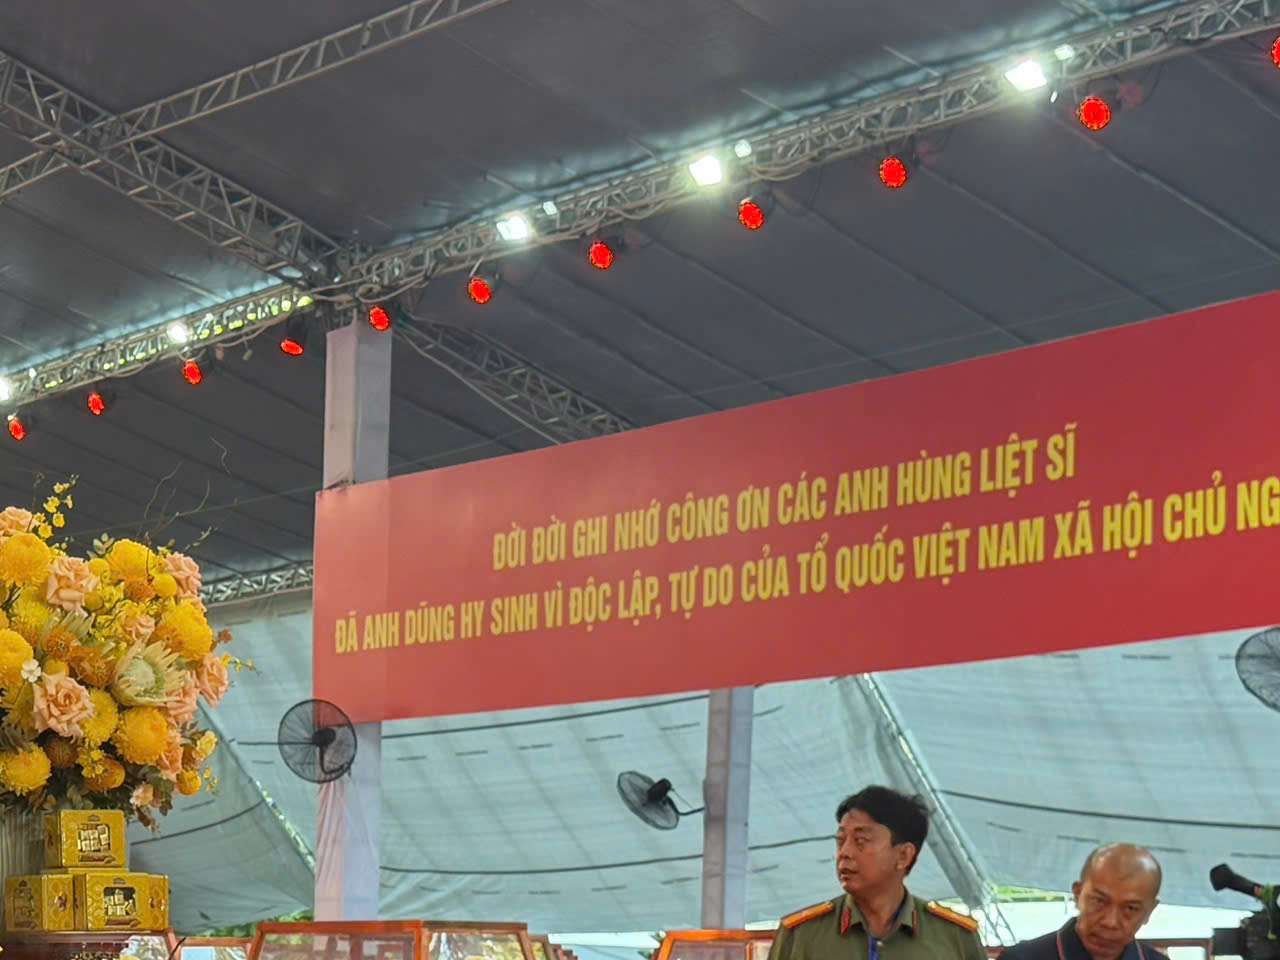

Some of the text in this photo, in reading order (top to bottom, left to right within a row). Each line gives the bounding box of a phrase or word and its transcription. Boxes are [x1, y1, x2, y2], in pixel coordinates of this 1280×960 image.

[335, 611, 360, 654] ĐÃ
[362, 611, 400, 651] ANH
[404, 601, 456, 646] DŨNG
[460, 600, 485, 638] HY
[490, 593, 538, 636] SINH
[544, 580, 564, 629] VÌ
[569, 576, 612, 632] ĐỘC
[618, 569, 662, 626] LẬP,
[668, 565, 702, 620] TỰ
[703, 564, 734, 607] DO
[741, 544, 790, 602] CỦA
[797, 532, 829, 594] TỔ
[835, 524, 905, 594] QUỐC
[913, 521, 971, 585] VIỆT
[978, 516, 1045, 570] NAM
[1053, 500, 1094, 559] XÃ
[1103, 491, 1153, 559] HỘI
[1163, 470, 1227, 543] CHỦ
[492, 423, 1078, 571] ĐỜI ĐỜI GHI NHỚ CÔNG ƠN CÁC ANH HÙNG LIỆT SĨ
